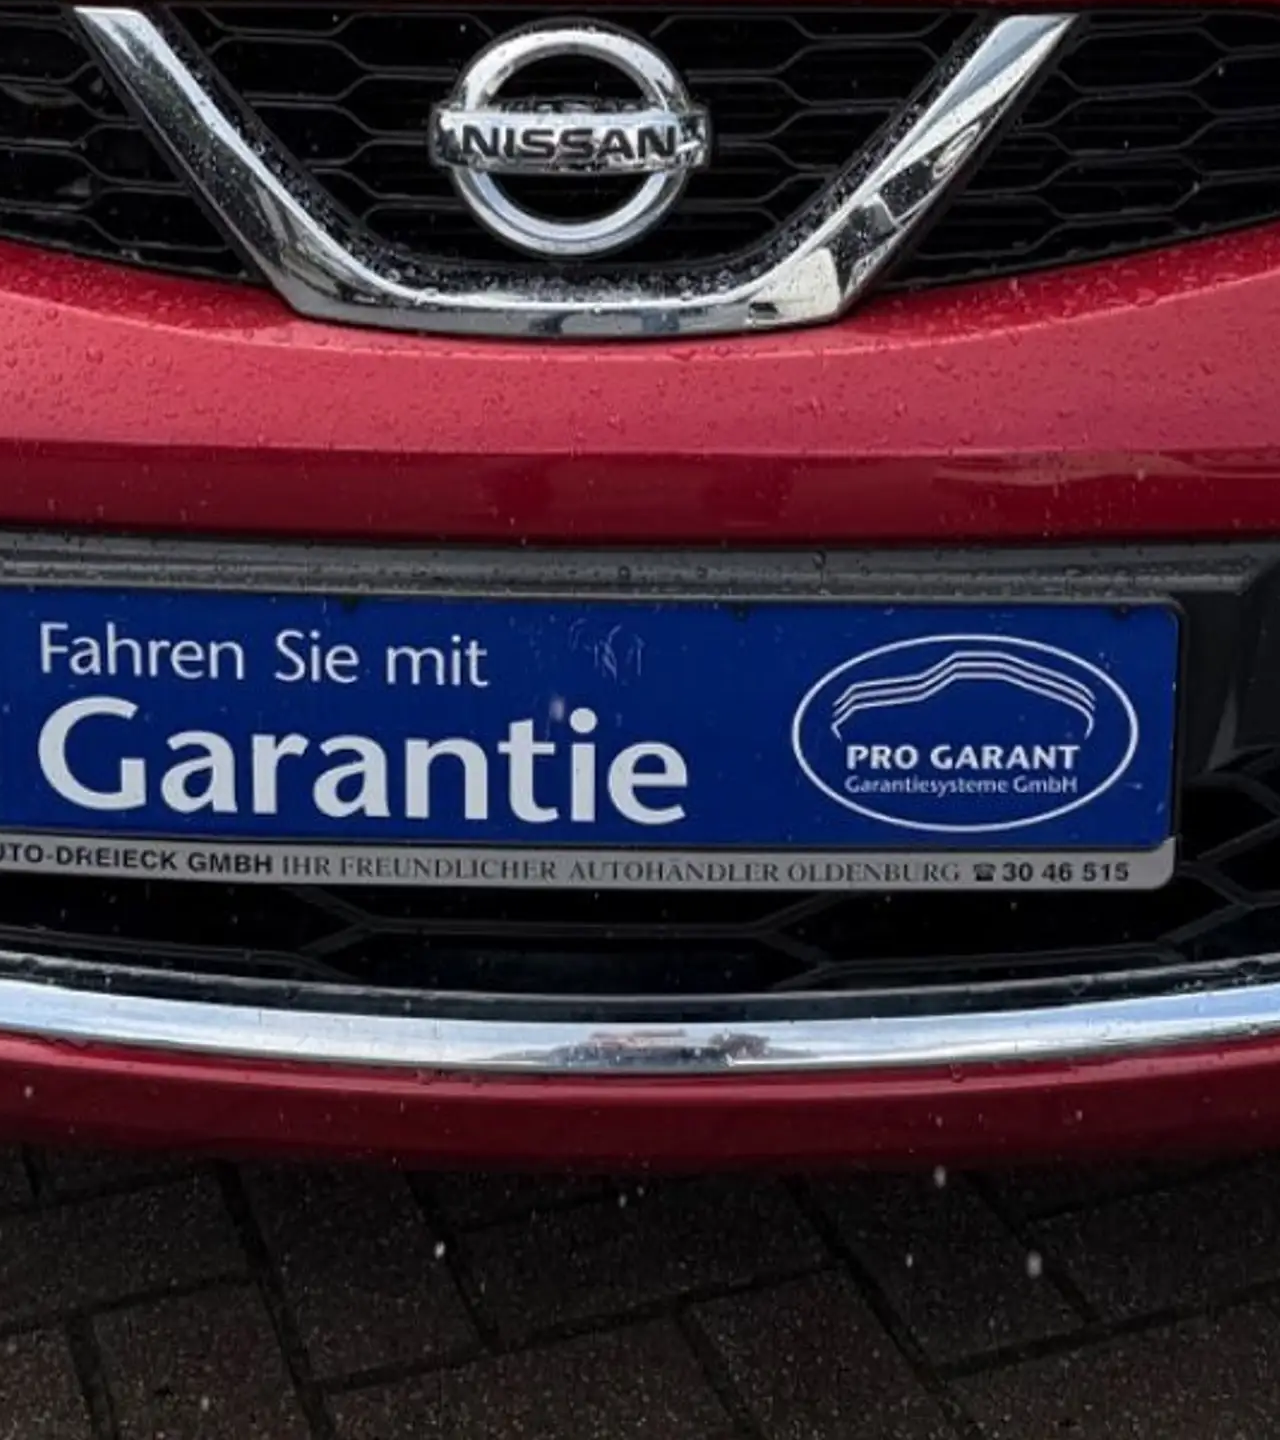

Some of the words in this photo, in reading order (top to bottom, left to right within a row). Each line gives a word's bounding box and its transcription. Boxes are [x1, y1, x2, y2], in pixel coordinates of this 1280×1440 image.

[461, 123, 676, 160] NISSAN
[39, 621, 245, 681] Fahren
[274, 628, 360, 684] Sie
[386, 633, 490, 687] mit
[36, 694, 689, 826] Garantie
[845, 744, 919, 770] PRO
[929, 744, 1081, 771] GARANT
[843, 775, 1010, 798] Garantiesysteme
[1012, 775, 1079, 794] GmbH
[186, 851, 274, 875] GMBH
[281, 855, 331, 877] IHR
[339, 855, 558, 881] FREUNDLICHER
[569, 858, 780, 883] AUTOHÄNDLER
[786, 861, 960, 883] OLDENBURG
[1002, 861, 1034, 882] 30
[1040, 861, 1074, 882] 46
[1080, 861, 1131, 882] 515
